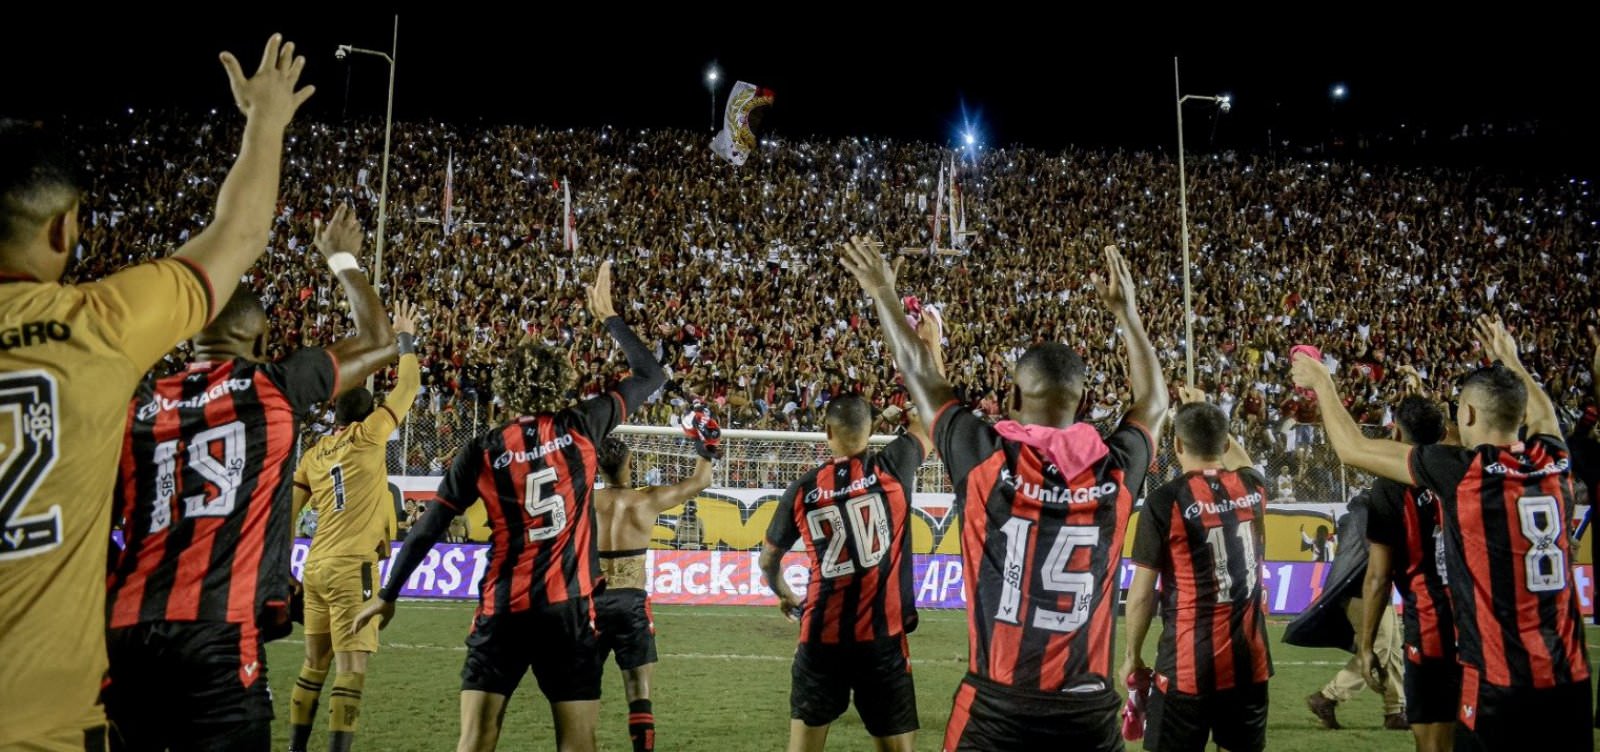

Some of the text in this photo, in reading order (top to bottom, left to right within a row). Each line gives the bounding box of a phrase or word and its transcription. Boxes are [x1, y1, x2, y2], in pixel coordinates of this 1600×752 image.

[0, 319, 71, 351] GRO
[29, 402, 52, 441] SBS
[515, 433, 573, 463] UniAGRO
[149, 420, 246, 533] 19
[161, 473, 174, 497] SBS
[330, 463, 346, 512] 1
[823, 473, 877, 500] UniAGRO
[1023, 482, 1116, 503] UniAGRO
[525, 466, 567, 542] 5
[1205, 492, 1262, 514] UniAGRO
[806, 492, 891, 578] 20
[1518, 495, 1566, 592] 8
[917, 560, 967, 602] AP
[995, 516, 1100, 632] 15
[1006, 562, 1021, 588] SBS
[1206, 520, 1258, 603] 11
